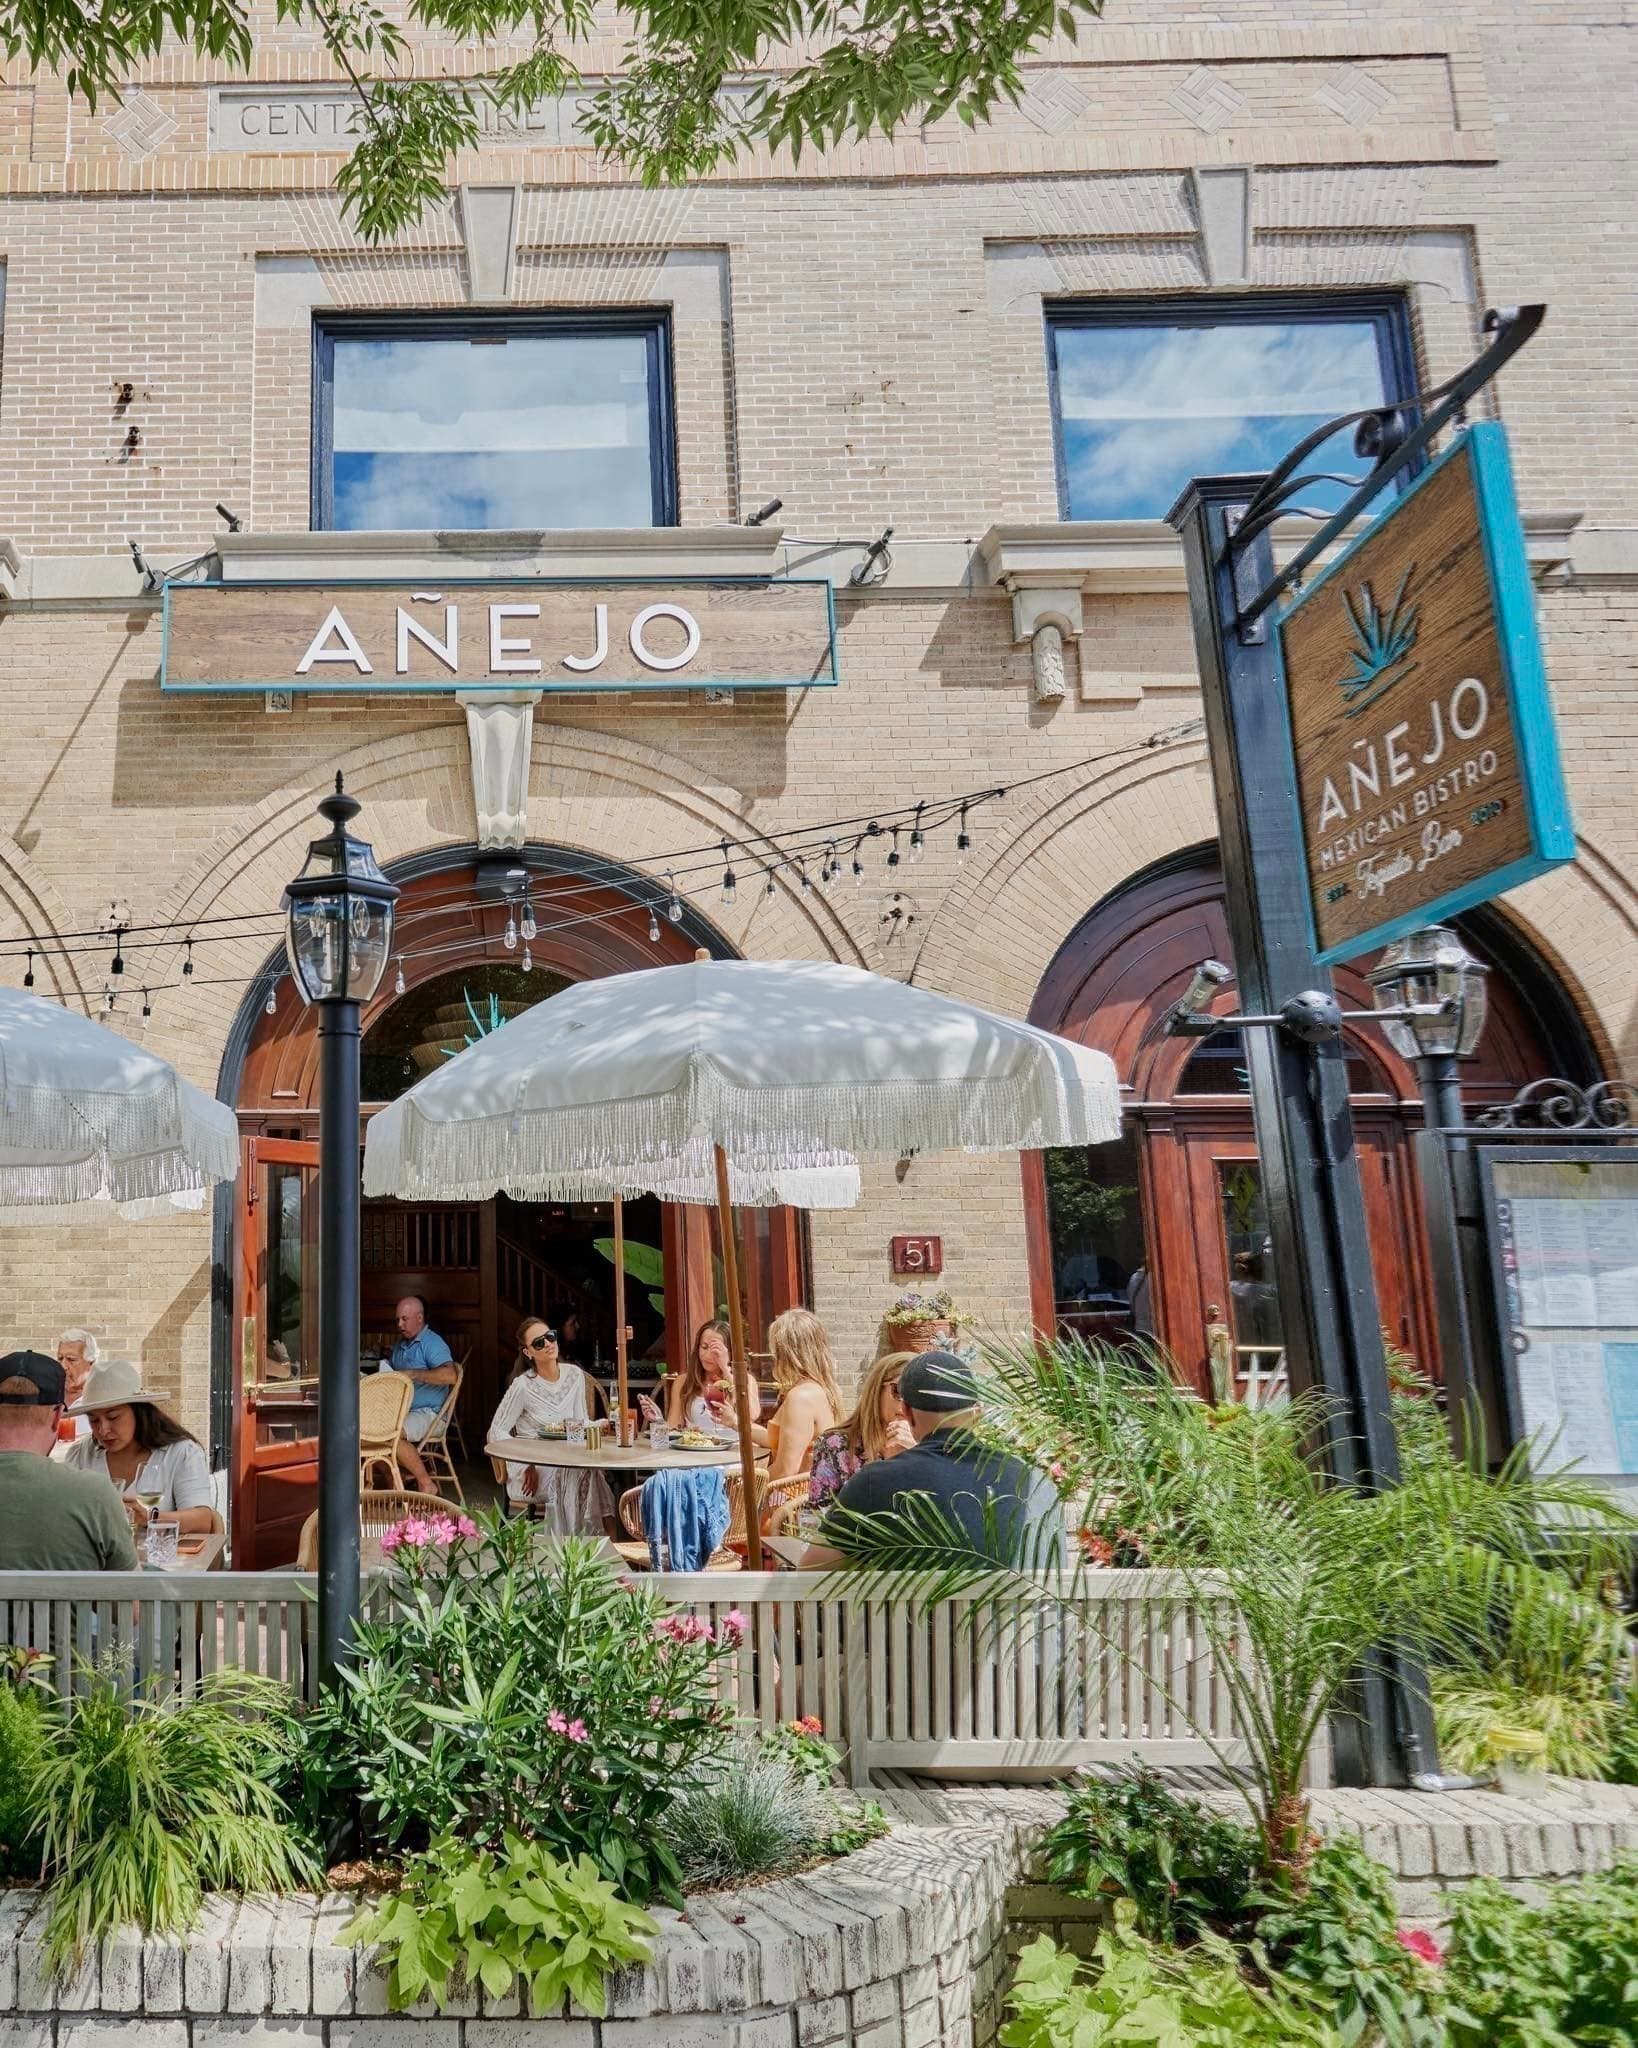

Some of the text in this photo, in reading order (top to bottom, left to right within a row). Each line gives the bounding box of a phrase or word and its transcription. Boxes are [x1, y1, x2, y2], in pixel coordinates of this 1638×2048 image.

[240, 102, 424, 135] CENTR
[456, 99, 546, 131] IRE
[295, 592, 701, 674] AÑEJO
[1317, 677, 1489, 834] AÑEJO
[1319, 749, 1498, 871] MEXICAN BISTRO
[906, 1240, 933, 1267] 51
